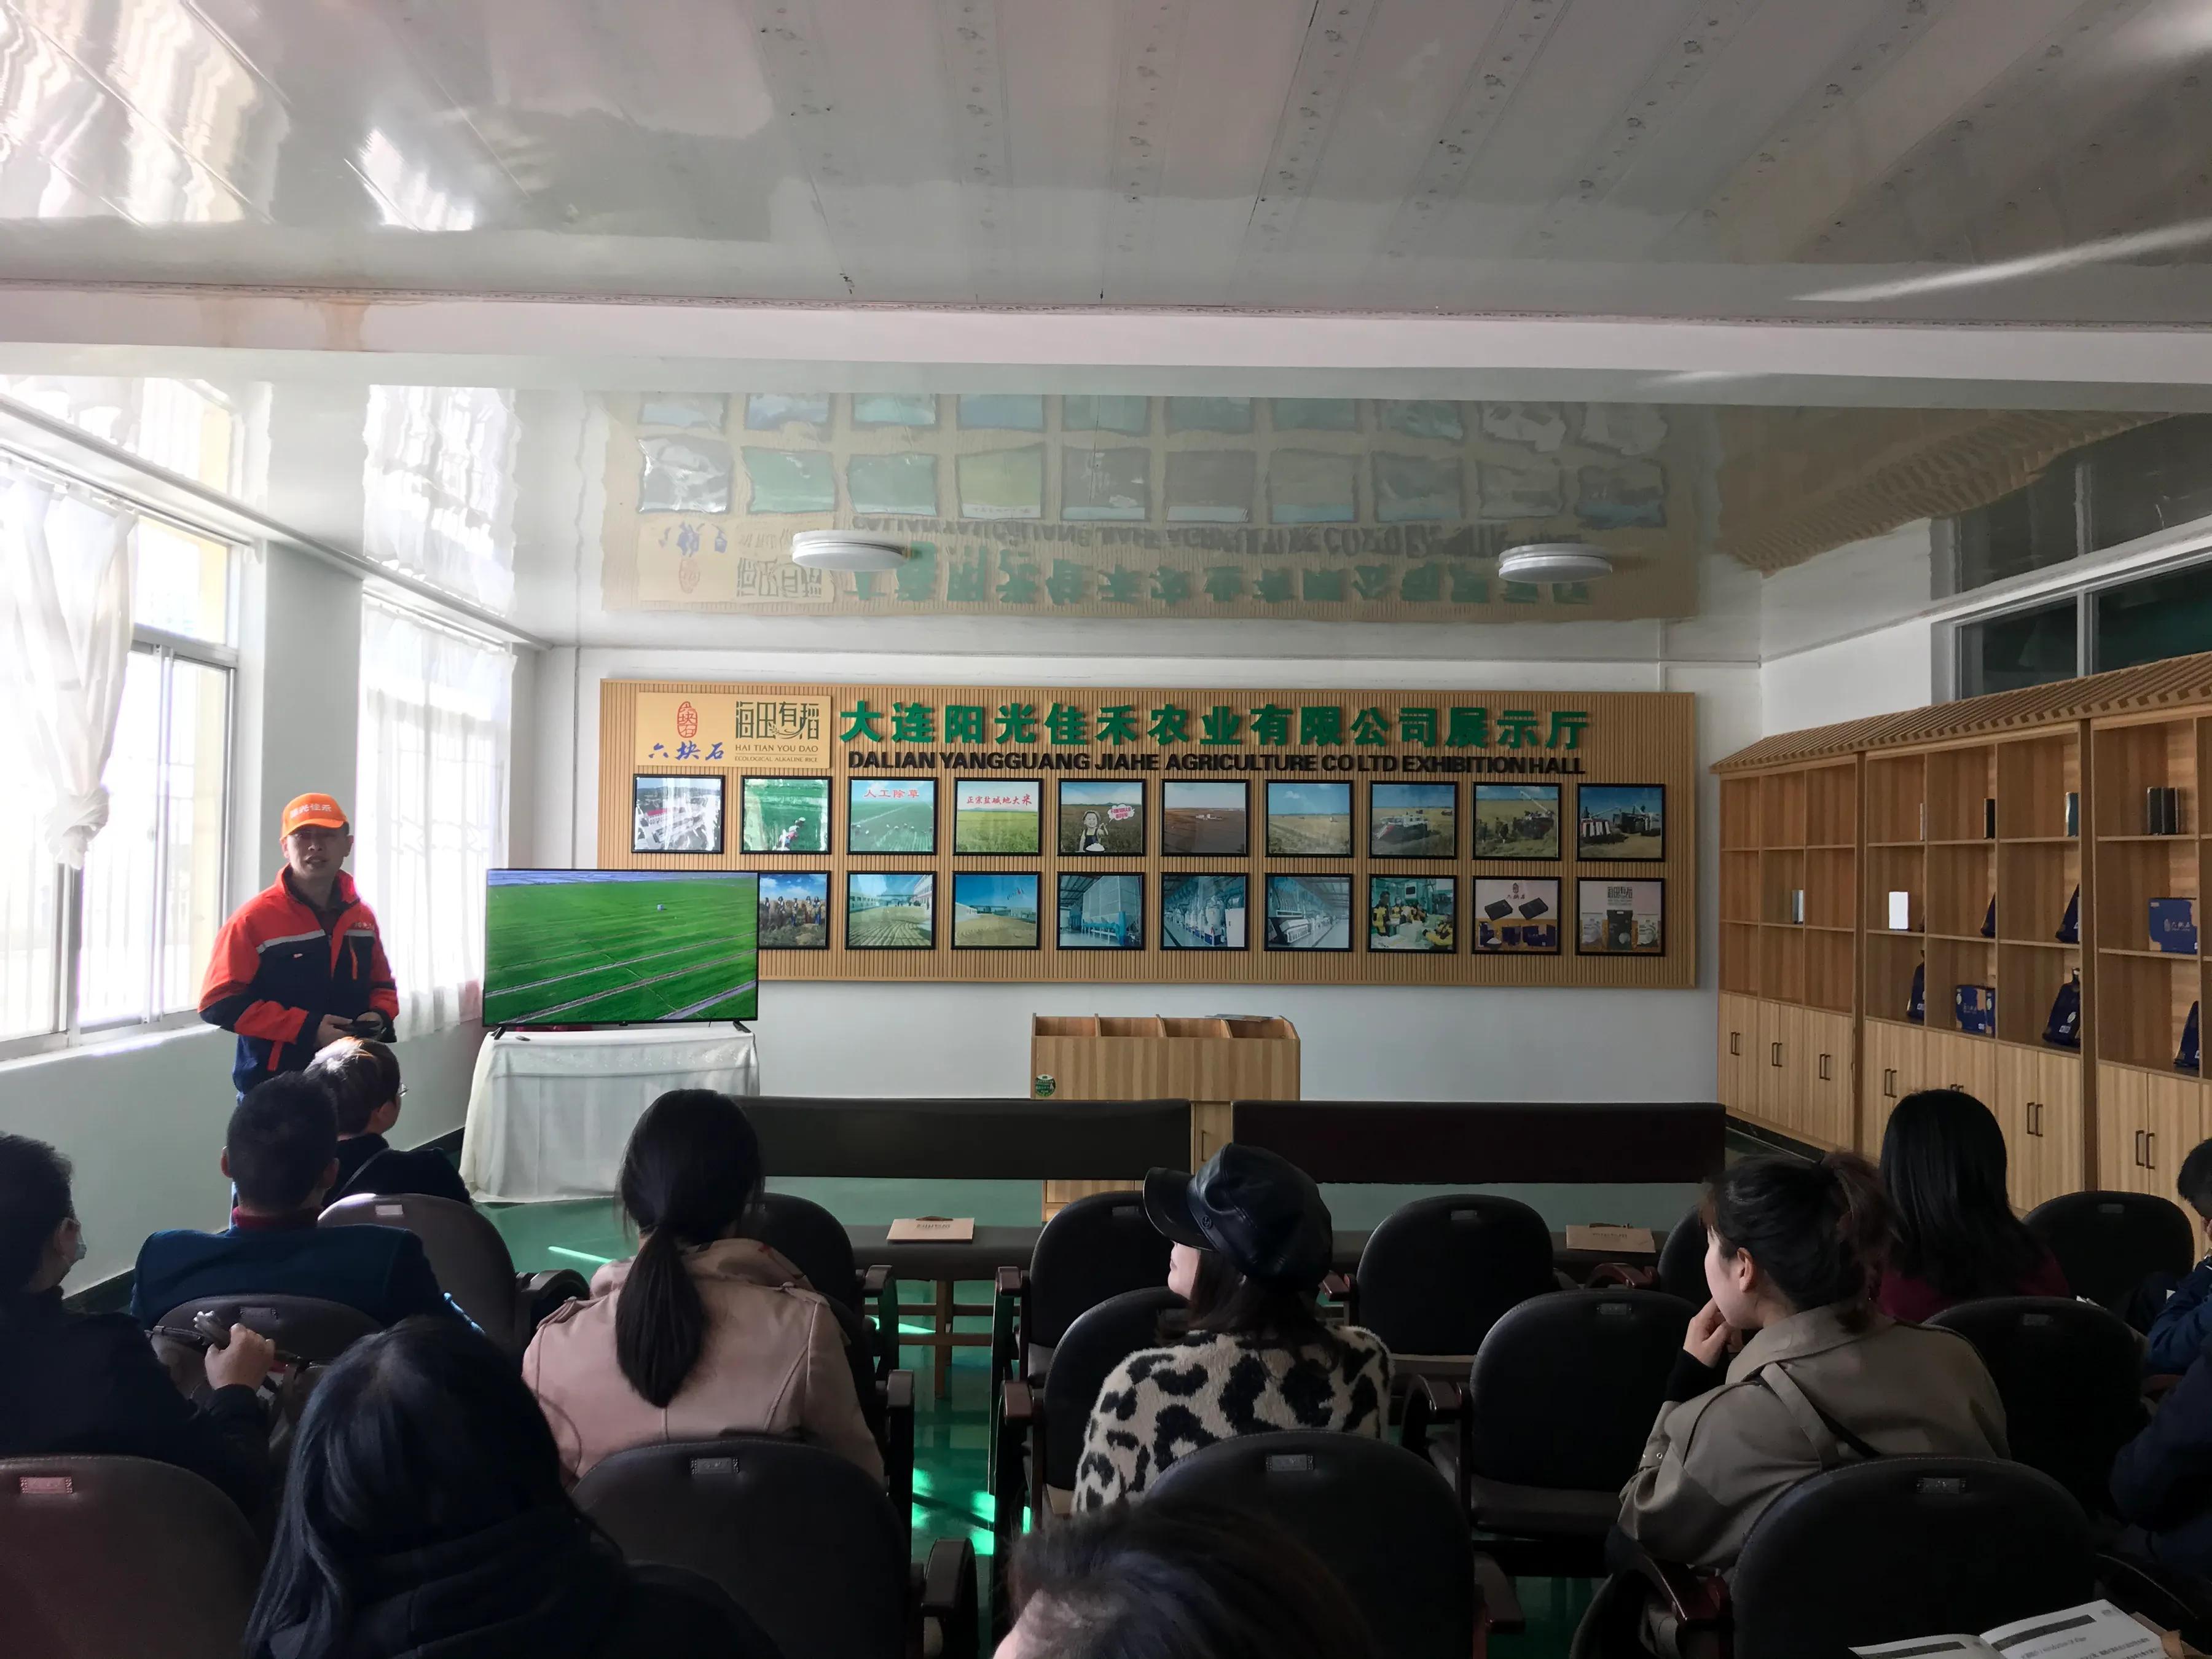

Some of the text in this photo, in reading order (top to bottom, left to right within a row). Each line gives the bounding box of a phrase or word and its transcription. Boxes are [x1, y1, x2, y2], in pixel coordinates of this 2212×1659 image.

[840, 700, 1588, 750] 大连阳光佳禾农业有限公司展示厅
[648, 740, 724, 761] 六块石
[848, 751, 1586, 774] DALIAN YANGGUANG JIAHE AGRICULTURE CO LTD EXHIBITION HALL
[865, 789, 920, 798] 人工除草
[967, 793, 1032, 806] 正宗盐碱地大米
[290, 803, 332, 819] 光佳禾
